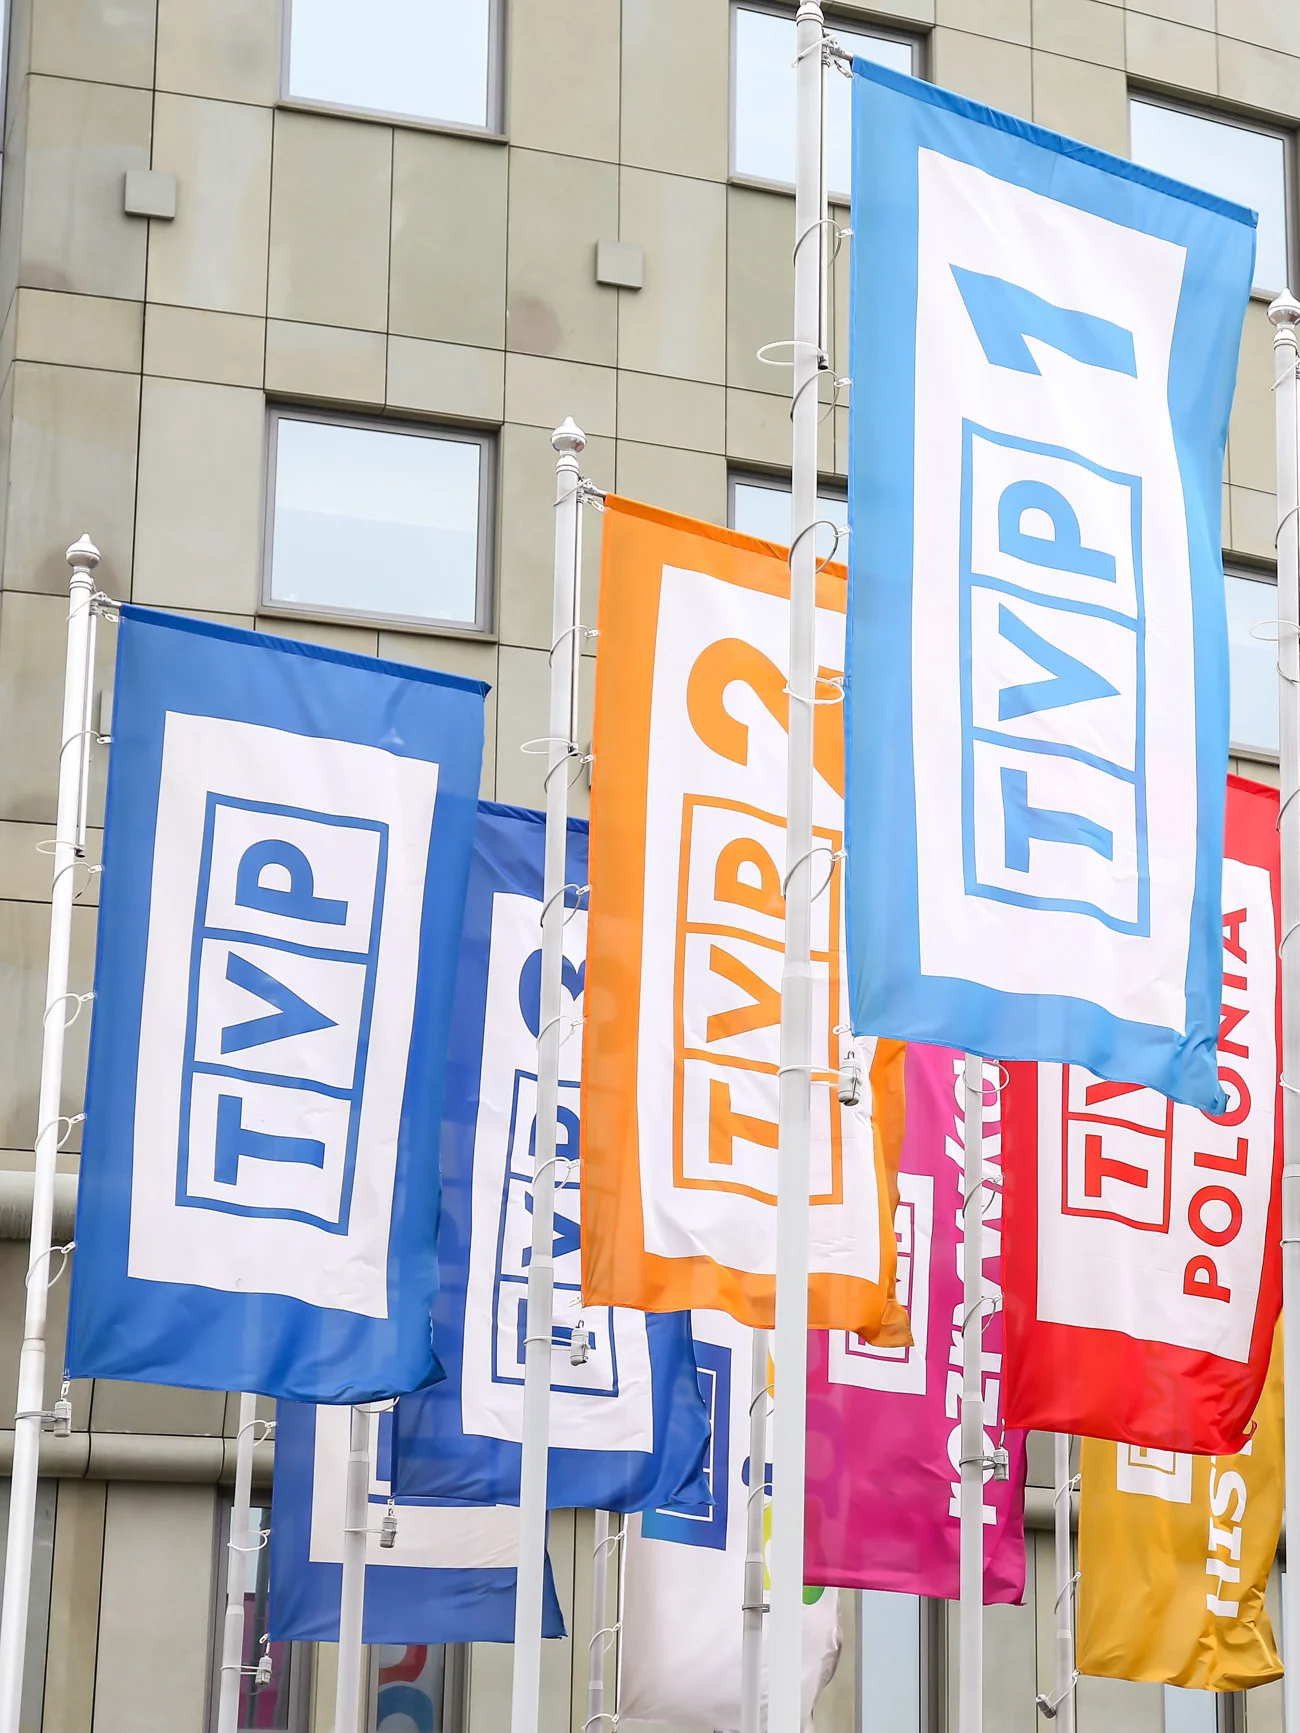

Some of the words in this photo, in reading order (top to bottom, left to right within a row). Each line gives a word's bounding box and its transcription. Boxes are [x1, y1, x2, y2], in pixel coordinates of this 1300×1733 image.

[949, 264, 1138, 378] 1
[686, 637, 845, 799] 2
[998, 479, 1121, 874] TVP
[212, 838, 349, 1187] TVP
